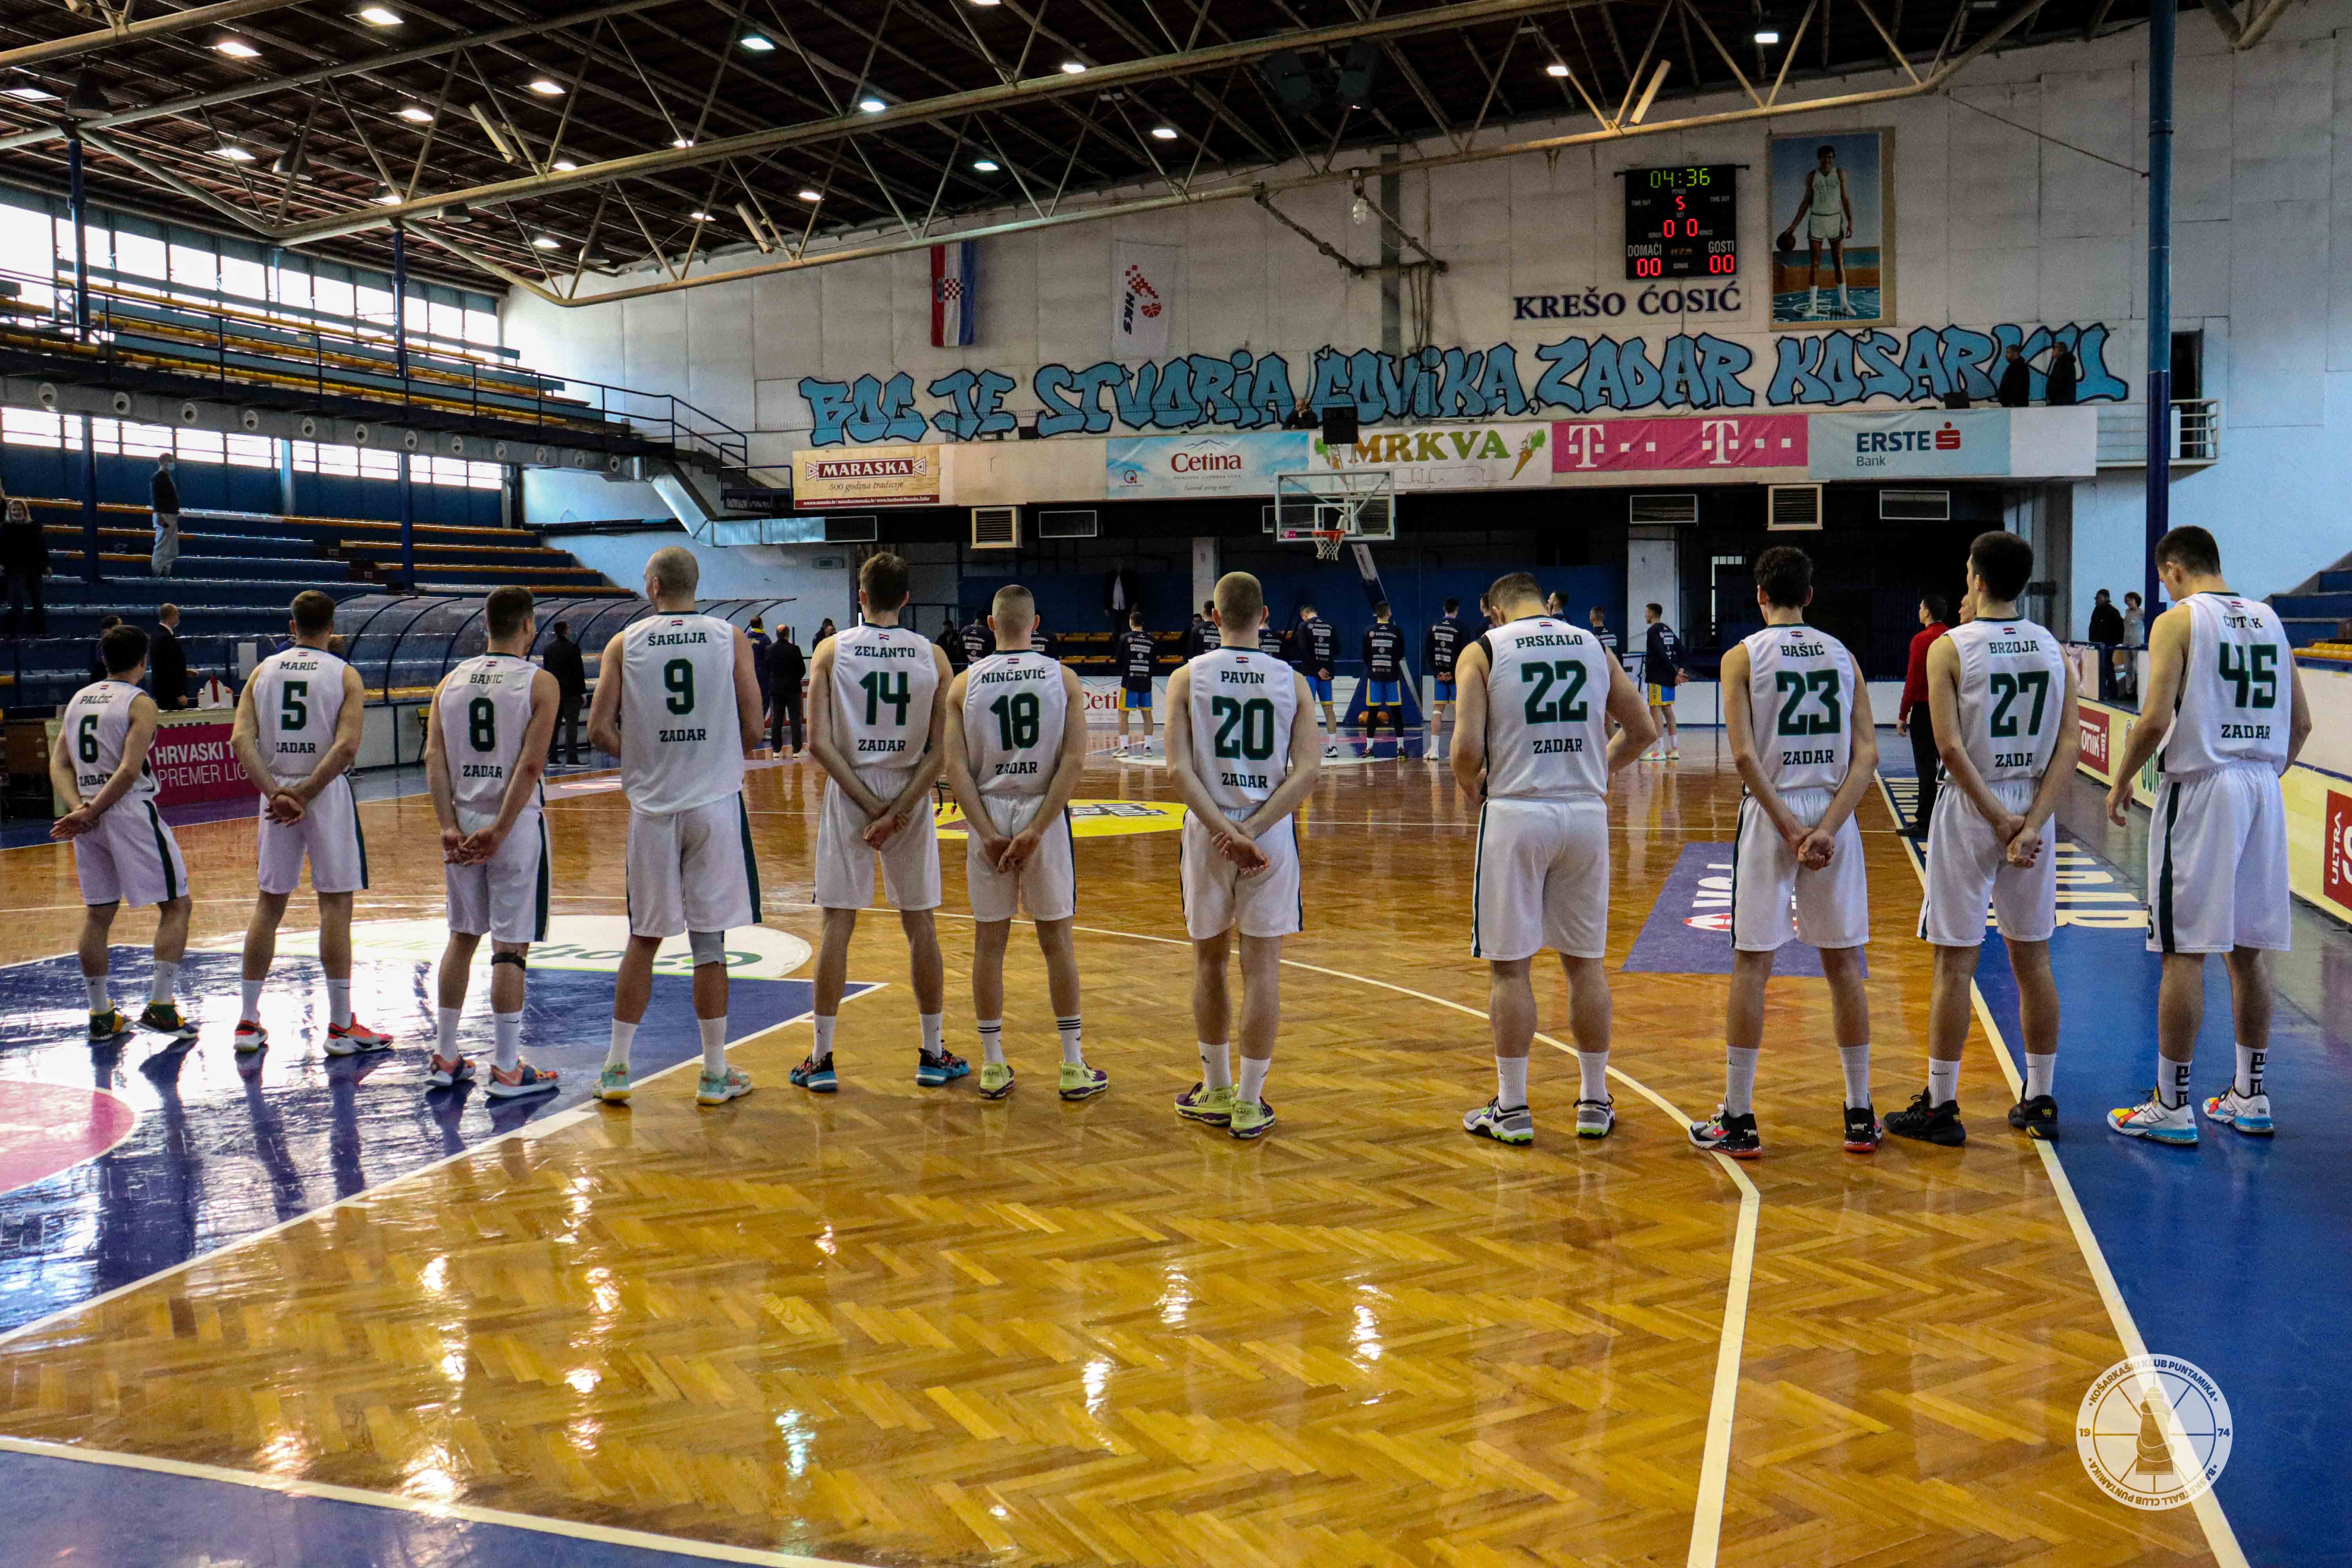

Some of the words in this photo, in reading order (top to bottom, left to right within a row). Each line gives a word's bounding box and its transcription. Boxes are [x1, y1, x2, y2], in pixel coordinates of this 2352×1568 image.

[1650, 168, 1710, 188] 04:36
[1663, 220, 1675, 238] 0
[1686, 218, 1698, 237] 0
[1708, 240, 1734, 253] GOSTI
[1637, 258, 1662, 277] 00
[1709, 254, 1734, 274] 00
[1514, 286, 1626, 320] KREŠO
[1637, 280, 1741, 315] ĆOSIĆ
[927, 369, 1018, 441] JE
[1535, 333, 1755, 414] ZADAR
[1348, 429, 1511, 465] MRKVA
[1856, 430, 1931, 453] ERSTE
[823, 461, 909, 477] MARASKA
[1171, 453, 1242, 473] Cetina
[1857, 456, 1886, 467] Bank
[846, 481, 870, 492] godina
[873, 480, 904, 490] tradicije
[648, 632, 707, 646] ŠARLIJA
[1515, 634, 1583, 650] PRSKALO
[1989, 640, 2040, 654] BRZOJA
[854, 645, 916, 658] ZELANTO
[1780, 641, 1825, 657] BAŠIĆ
[279, 660, 319, 671] MARIĆ
[981, 667, 1046, 684] NINČEVIĆ
[1221, 671, 1265, 684] PAVIN
[2219, 642, 2277, 709] 45
[664, 659, 694, 715] 9
[1521, 660, 1588, 725] 22
[80, 693, 114, 704] PALČIĆ
[281, 681, 307, 731] 5
[859, 671, 910, 726] 14
[1082, 691, 1117, 710] Ceti
[1775, 669, 1841, 736] 23
[1990, 670, 2050, 739] 27
[468, 697, 495, 752] 8
[990, 692, 1040, 751] 18
[1212, 695, 1274, 761] 20
[79, 714, 99, 763] 6
[659, 729, 707, 742] ZADAR
[2221, 724, 2270, 740] ZADAR
[858, 739, 906, 752] ZADAR
[1533, 738, 1583, 755] ZADAR
[1783, 749, 1834, 765] ZADAR
[1995, 753, 2033, 768] ZADA
[225, 762, 249, 781] LIG
[463, 765, 503, 779] ZADAR
[995, 762, 1038, 776] ZADAR
[1221, 773, 1268, 789] ZADAR
[2332, 811, 2342, 885] ULTRA
